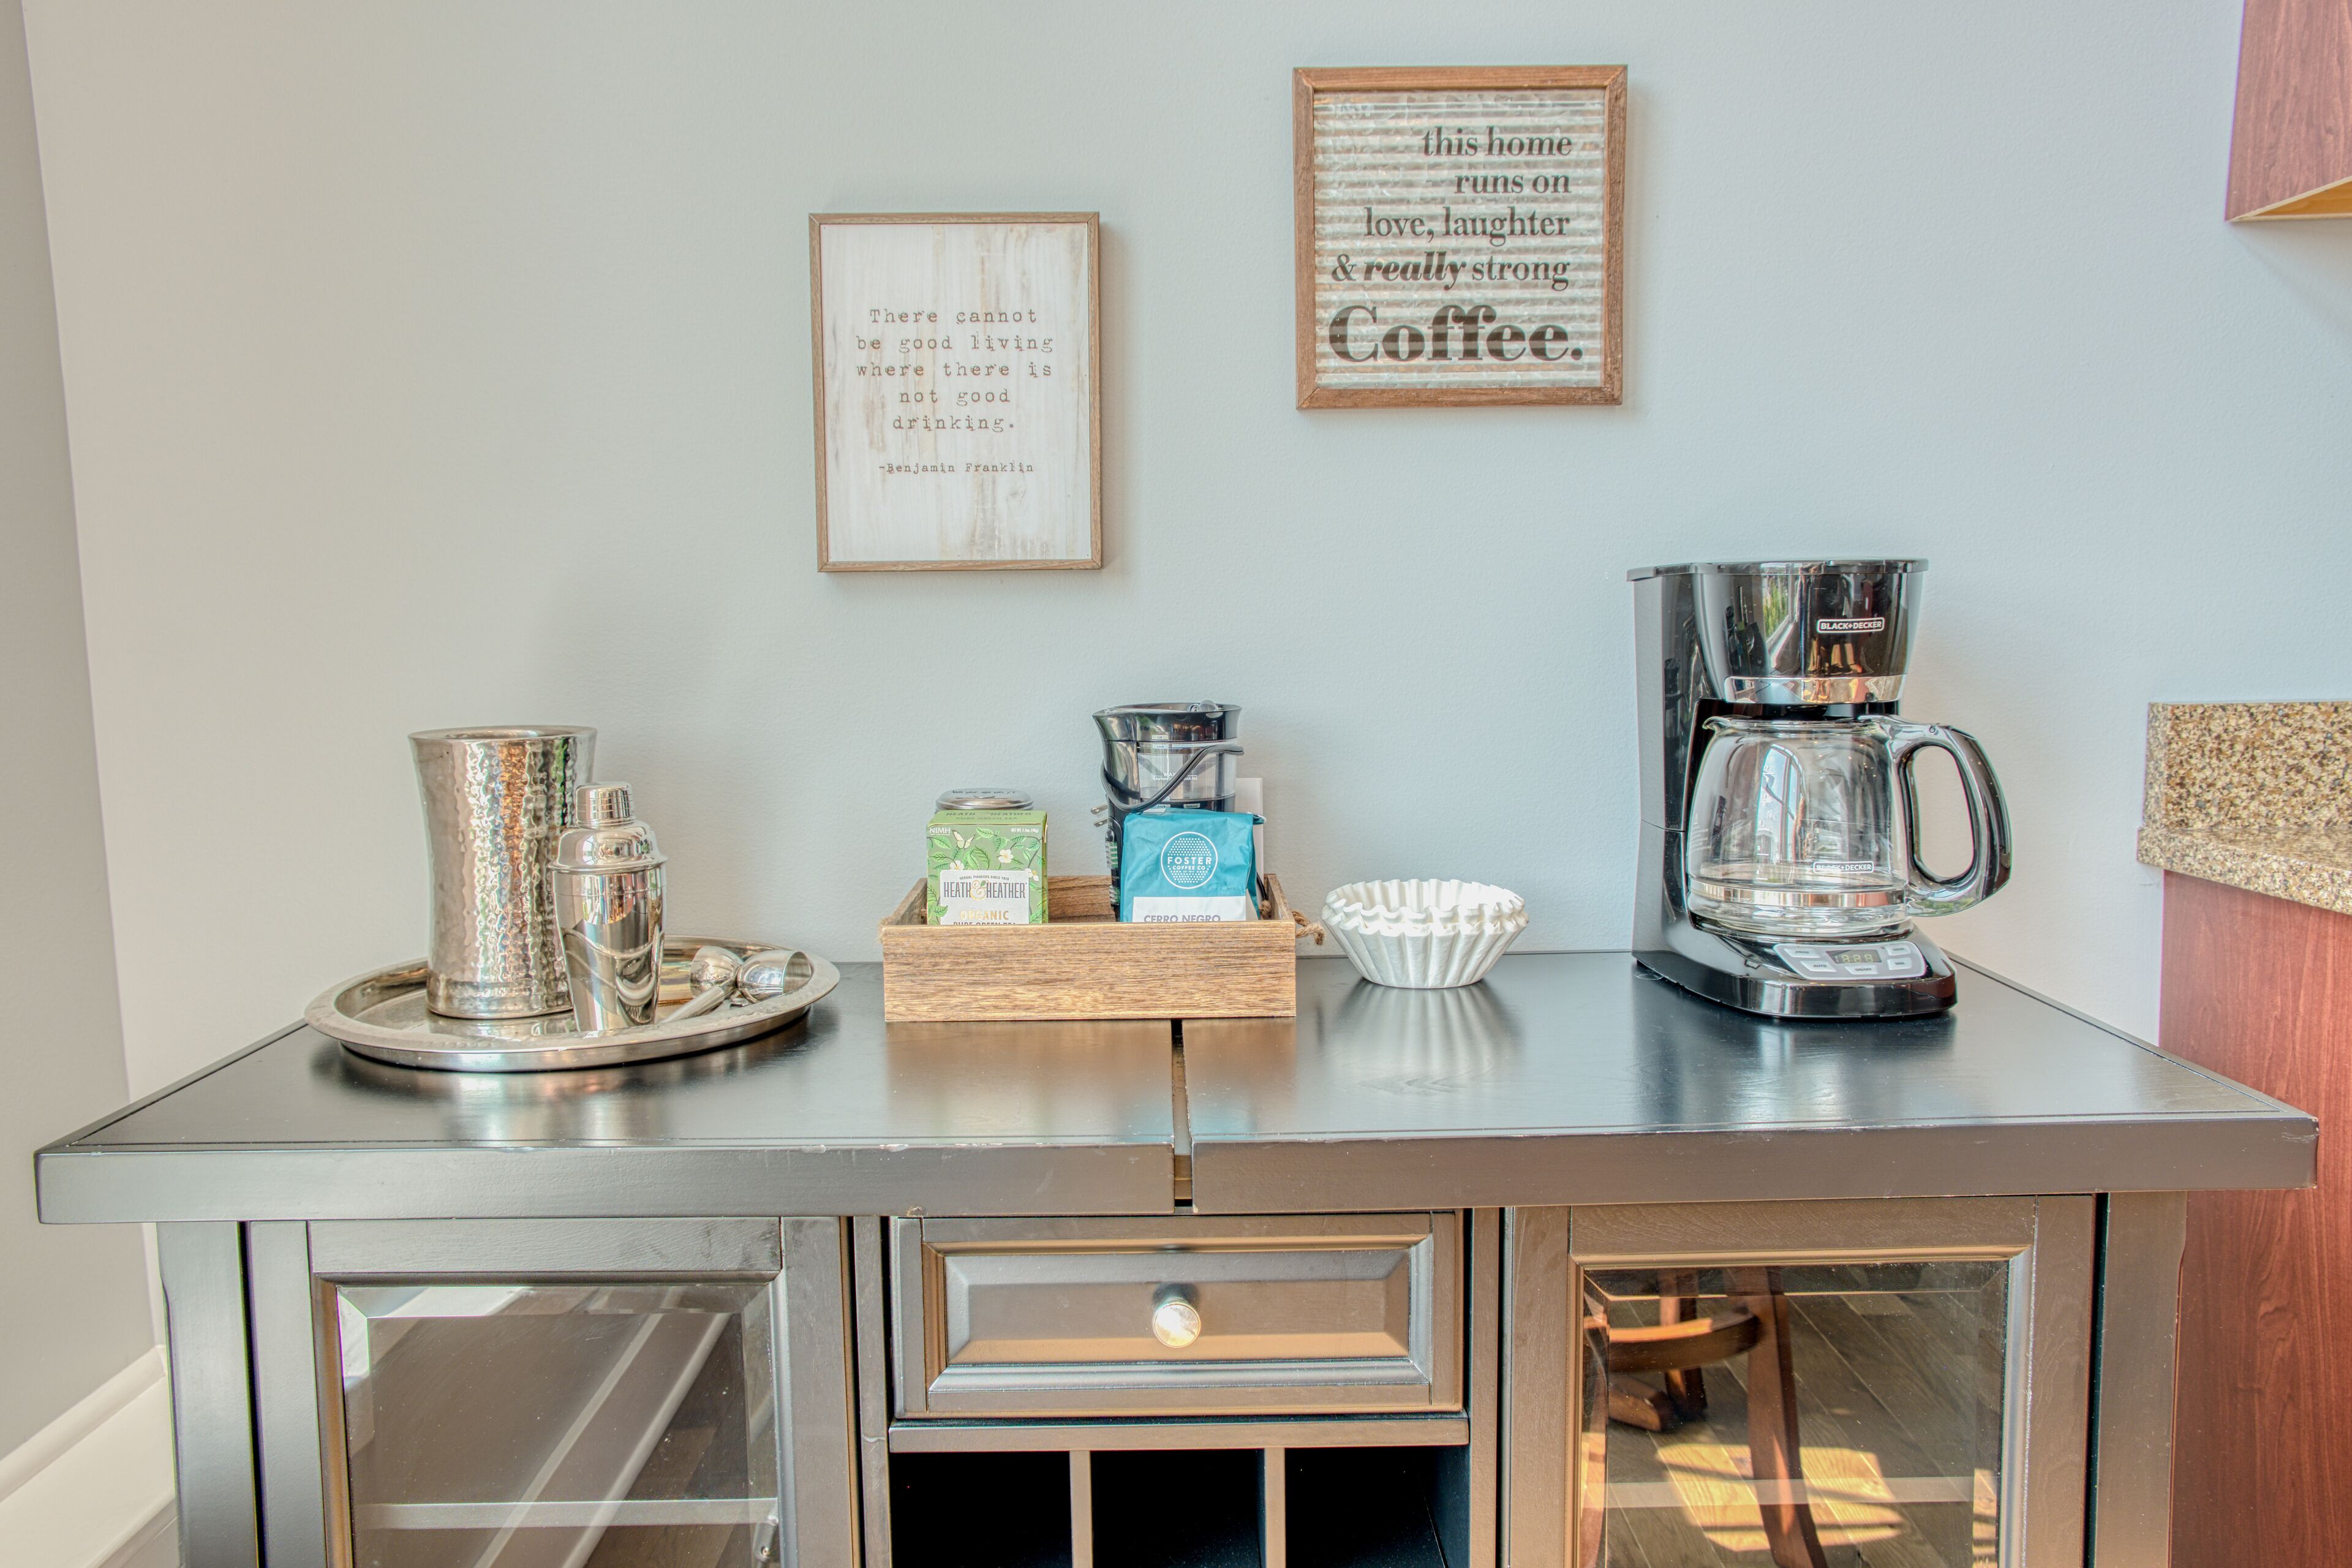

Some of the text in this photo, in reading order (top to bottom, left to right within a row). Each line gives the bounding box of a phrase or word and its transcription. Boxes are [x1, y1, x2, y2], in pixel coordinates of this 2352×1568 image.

[1422, 125, 1572, 156] this home
[1454, 174, 1572, 194] runs on
[1363, 206, 1571, 247] love, laughter
[1331, 251, 1571, 291] & really strong
[870, 309, 1038, 325] There cannot
[1329, 304, 1583, 363] Coffee.
[857, 333, 1054, 353] be good living
[856, 362, 1052, 378] where there is
[899, 388, 1011, 406] not good
[892, 416, 1015, 434] drinking.
[878, 461, 1035, 475] -Benjamin Franklin
[1820, 620, 1882, 630] BLACK+DECKER
[944, 882, 971, 898] HEATH
[960, 910, 1009, 921] ORGANIC
